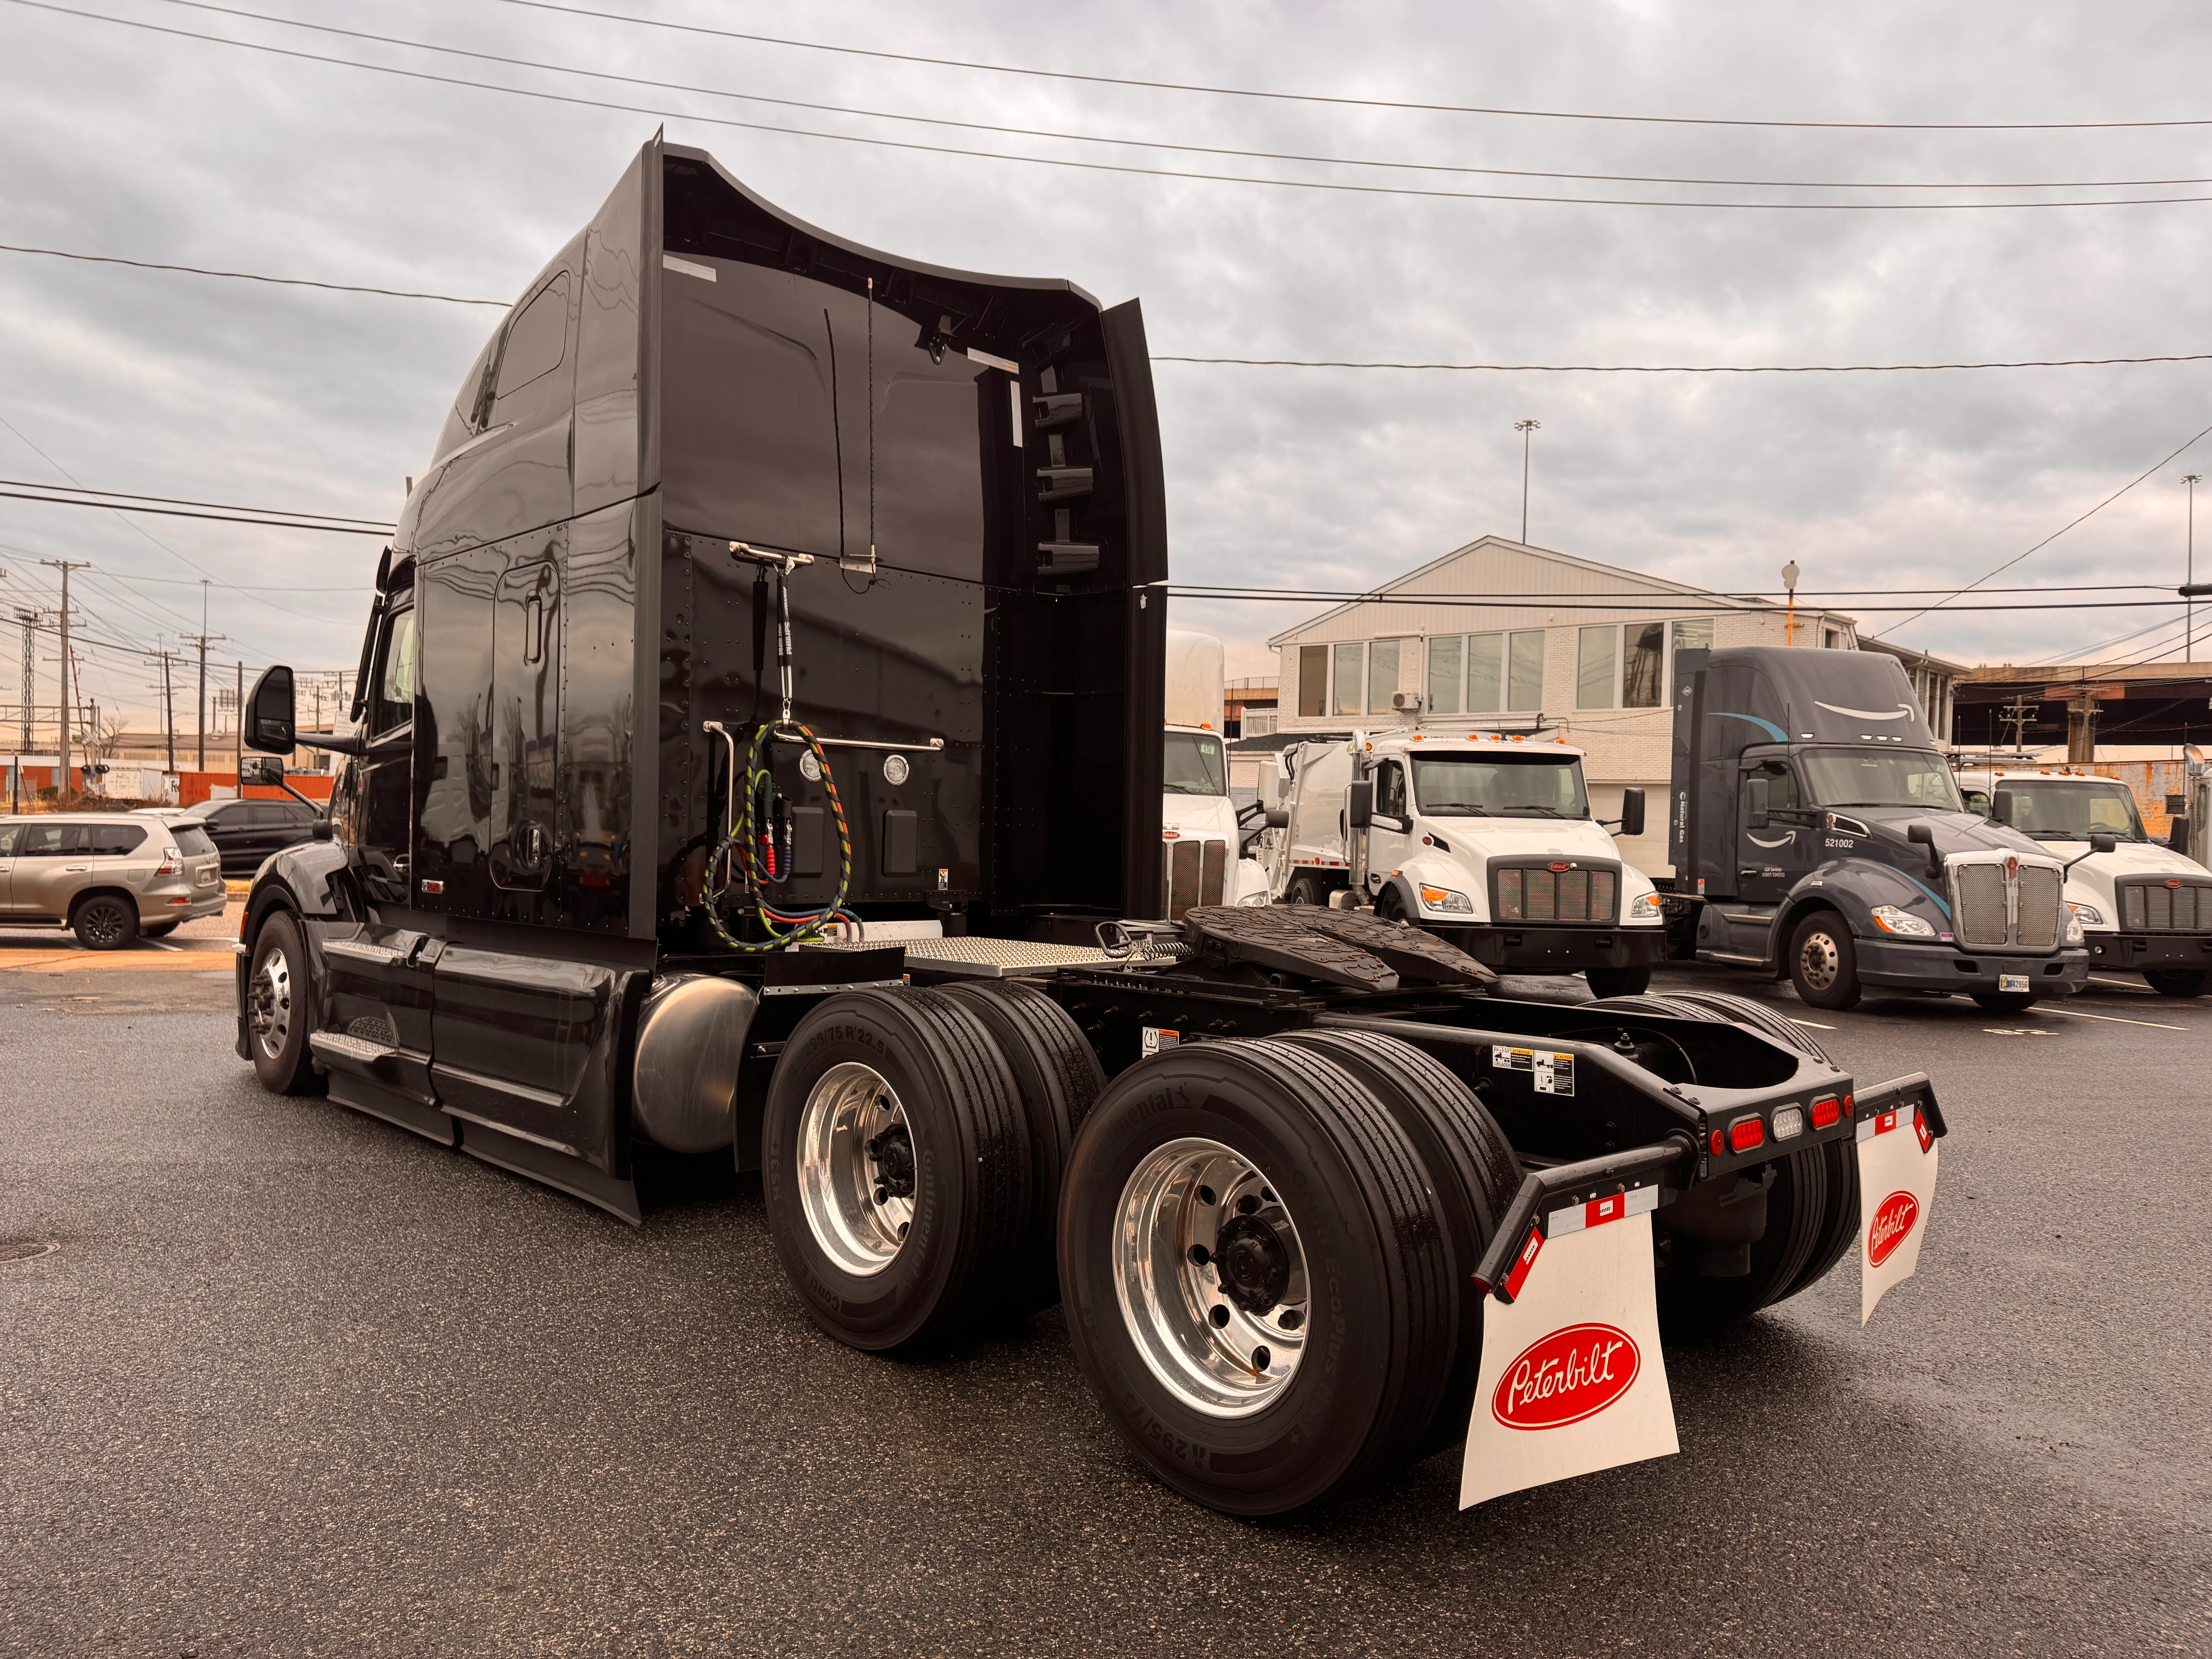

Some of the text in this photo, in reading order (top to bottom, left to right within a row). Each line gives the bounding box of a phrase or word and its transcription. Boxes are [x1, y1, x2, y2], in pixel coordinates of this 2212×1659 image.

[784, 622, 792, 655] PHILLIPS
[1825, 838, 1853, 848] 521002
[803, 1025, 843, 1058] 295/75
[857, 1028, 884, 1055] 22.5
[910, 1149, 936, 1278] Continental
[1870, 1203, 1914, 1257] Peterbilt
[810, 1277, 840, 1312] Conti
[1508, 1341, 1623, 1415] Peterbilt
